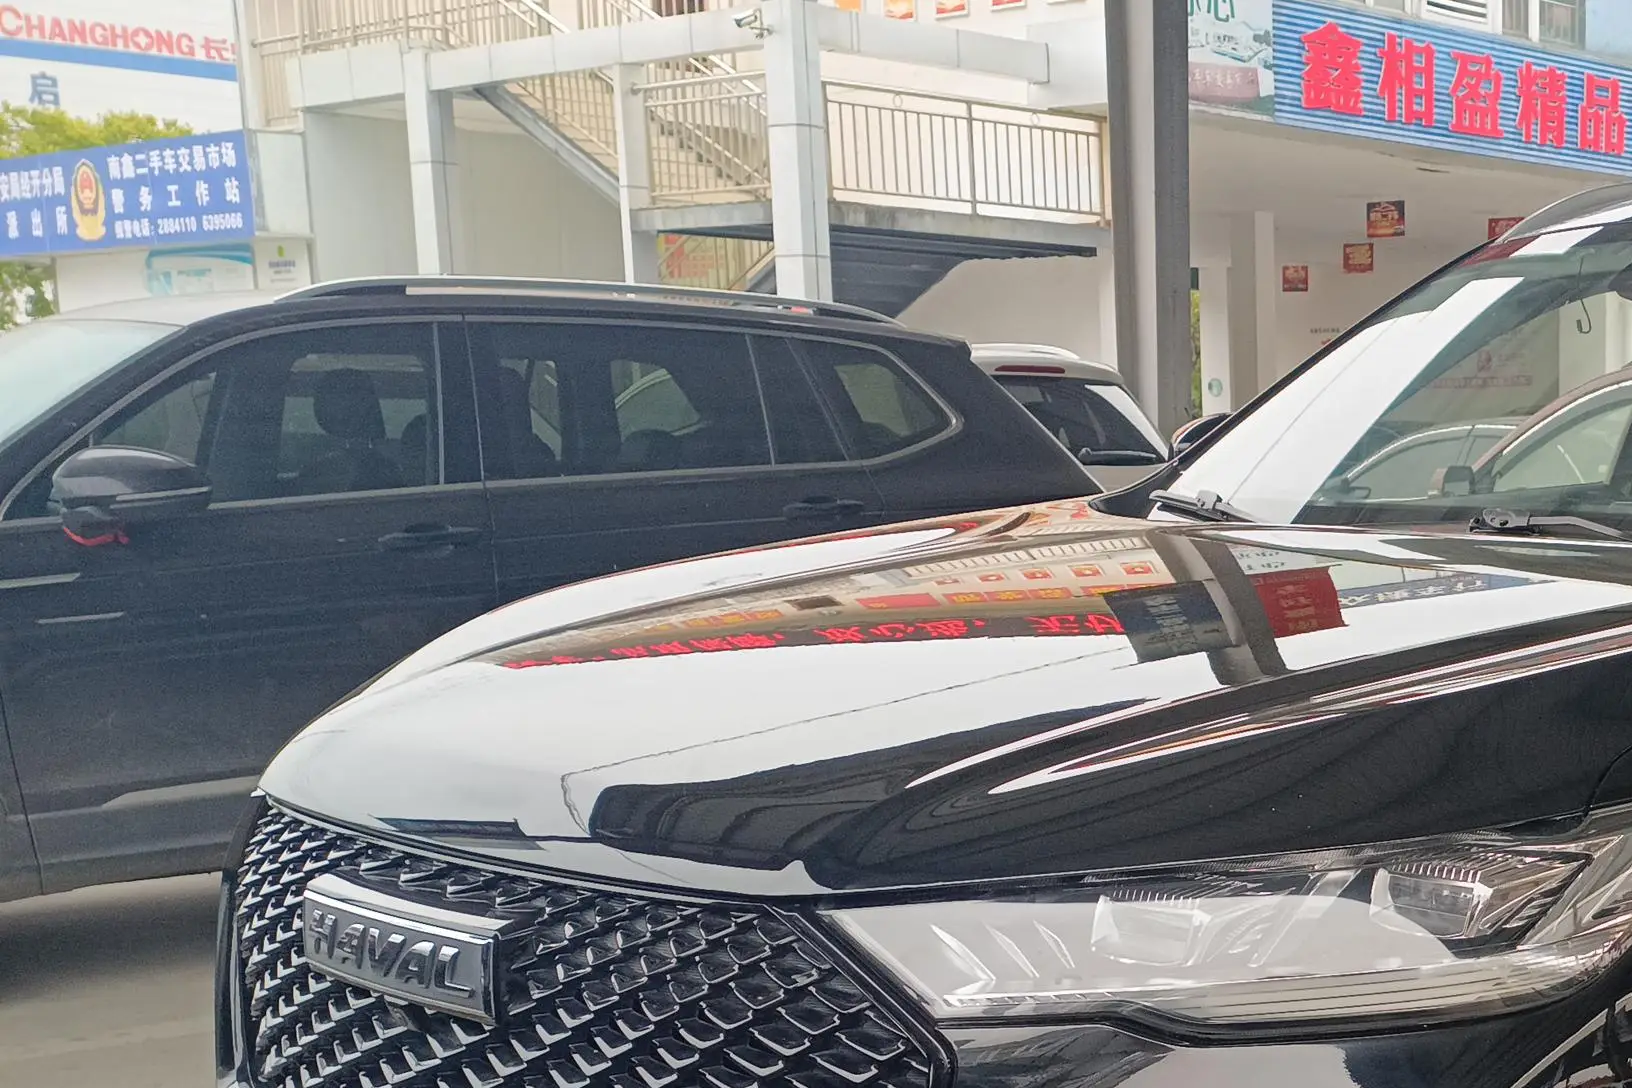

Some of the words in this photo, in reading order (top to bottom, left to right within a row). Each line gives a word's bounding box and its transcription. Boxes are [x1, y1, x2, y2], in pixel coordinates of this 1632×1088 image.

[0, 5, 195, 58] CHANGHONG
[201, 36, 237, 62] 长
[309, 908, 475, 999] HAVAL
